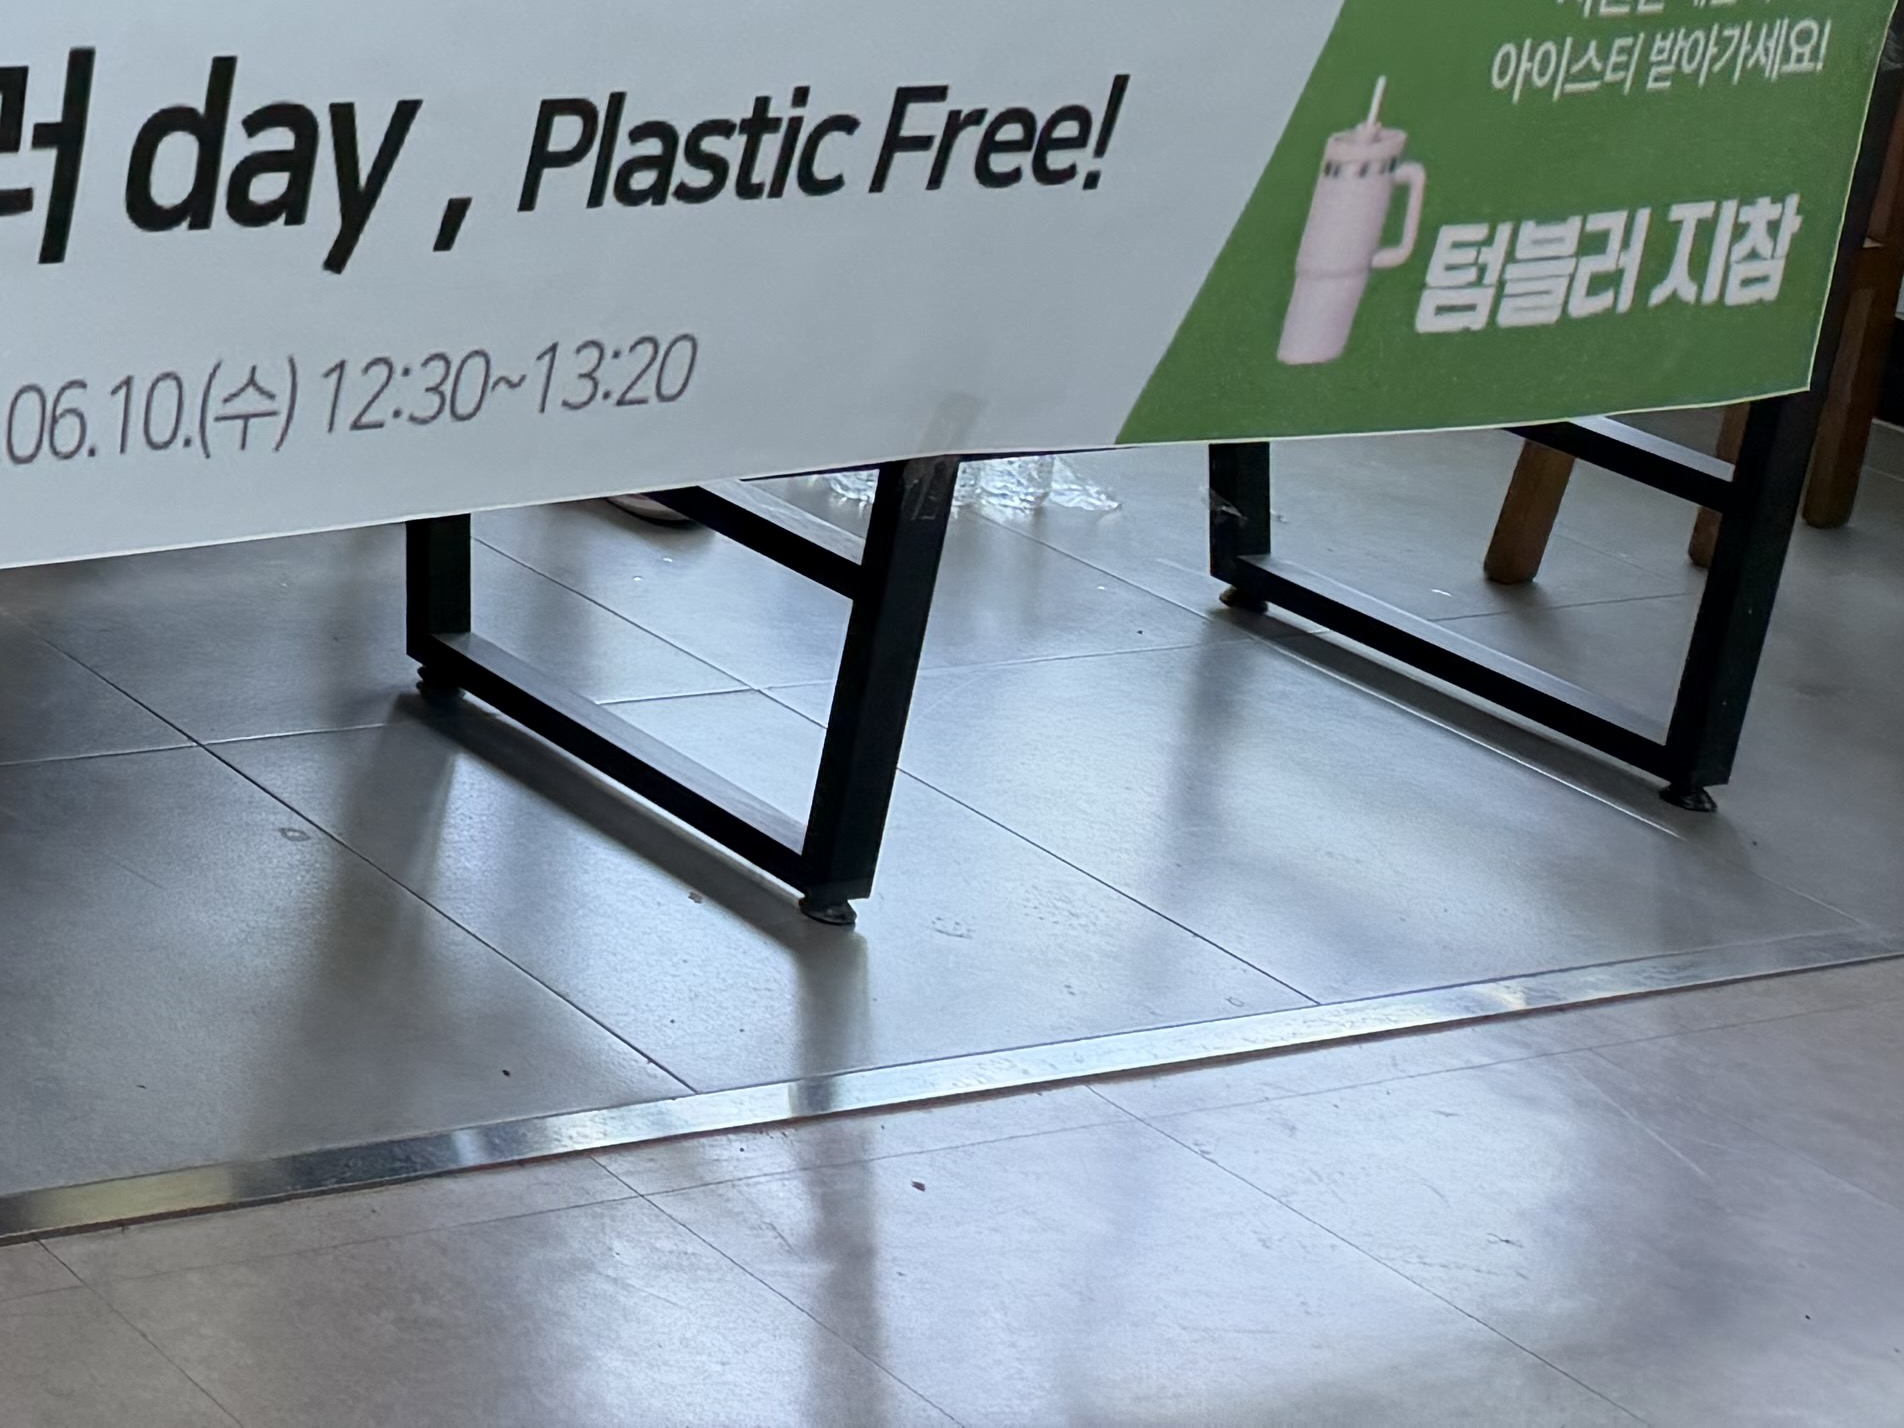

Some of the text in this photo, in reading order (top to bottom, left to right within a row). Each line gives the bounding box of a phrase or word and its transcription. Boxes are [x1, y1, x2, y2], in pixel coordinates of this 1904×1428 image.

[1490, 17, 1832, 105] 아이스티 받아가세요!
[515, 85, 861, 213] Plastic
[868, 73, 1132, 194] Free!
[1413, 193, 1804, 334] 텀블러 지참
[320, 332, 700, 435] 12:30~13:20
